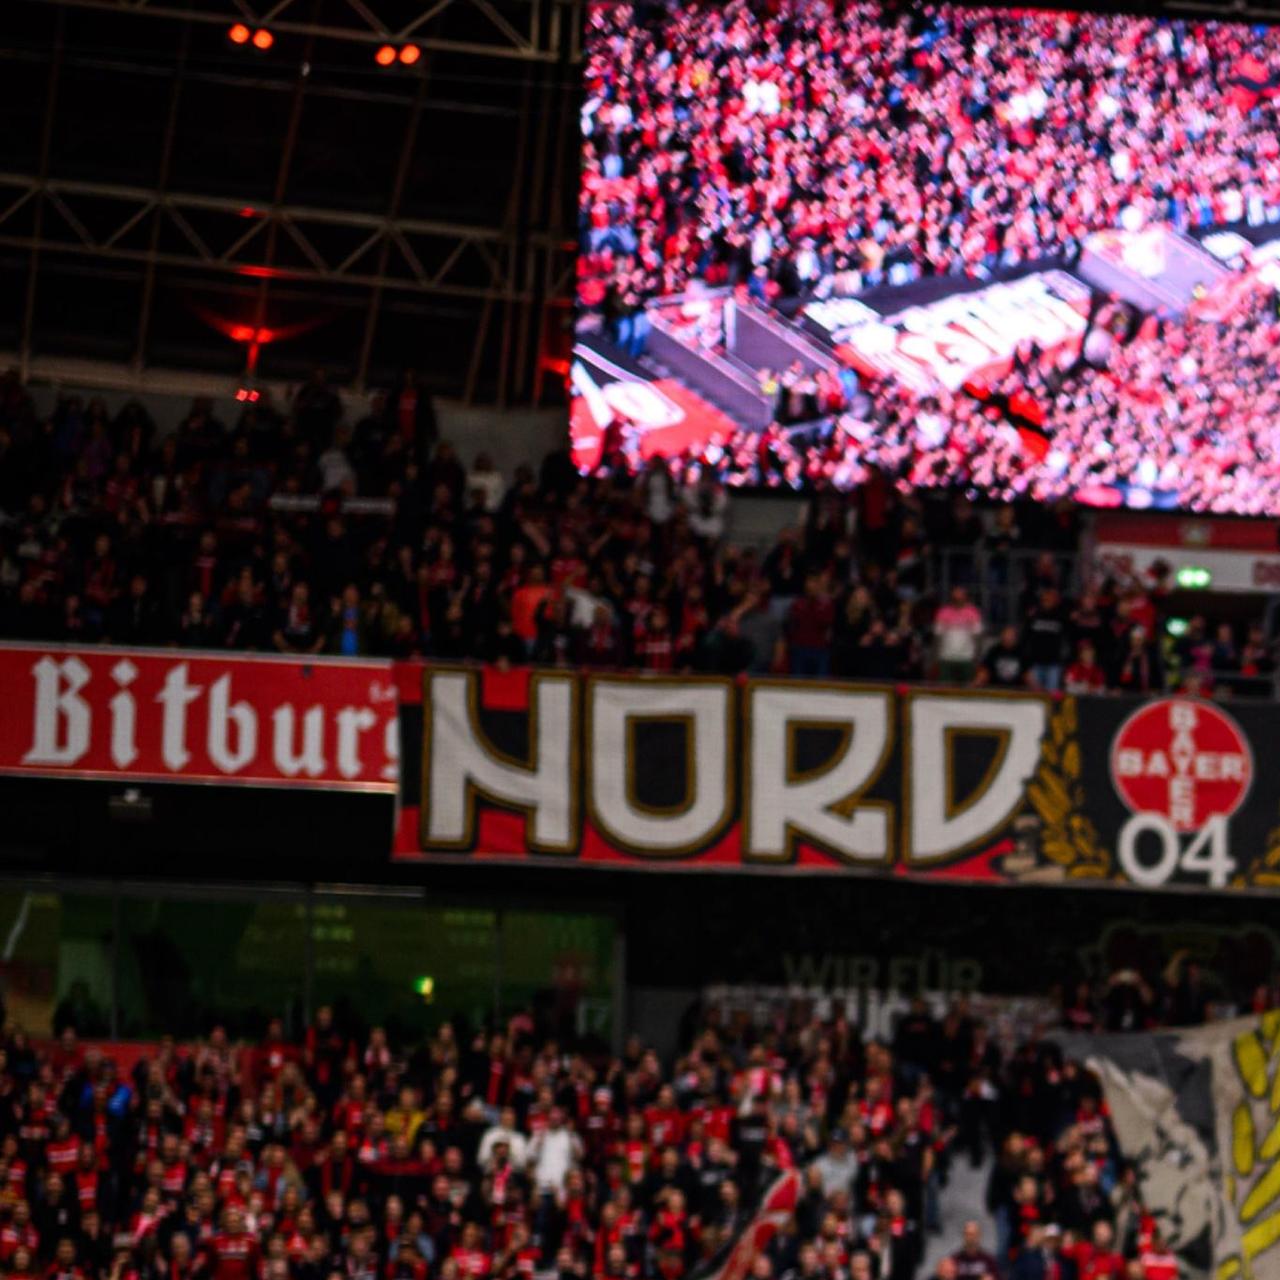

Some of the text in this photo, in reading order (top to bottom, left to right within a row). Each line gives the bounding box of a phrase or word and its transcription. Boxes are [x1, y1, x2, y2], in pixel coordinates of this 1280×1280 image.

[22, 655, 397, 779] Bitbur
[1115, 747, 1246, 780] BAYER
[1117, 811, 1236, 888] 04
